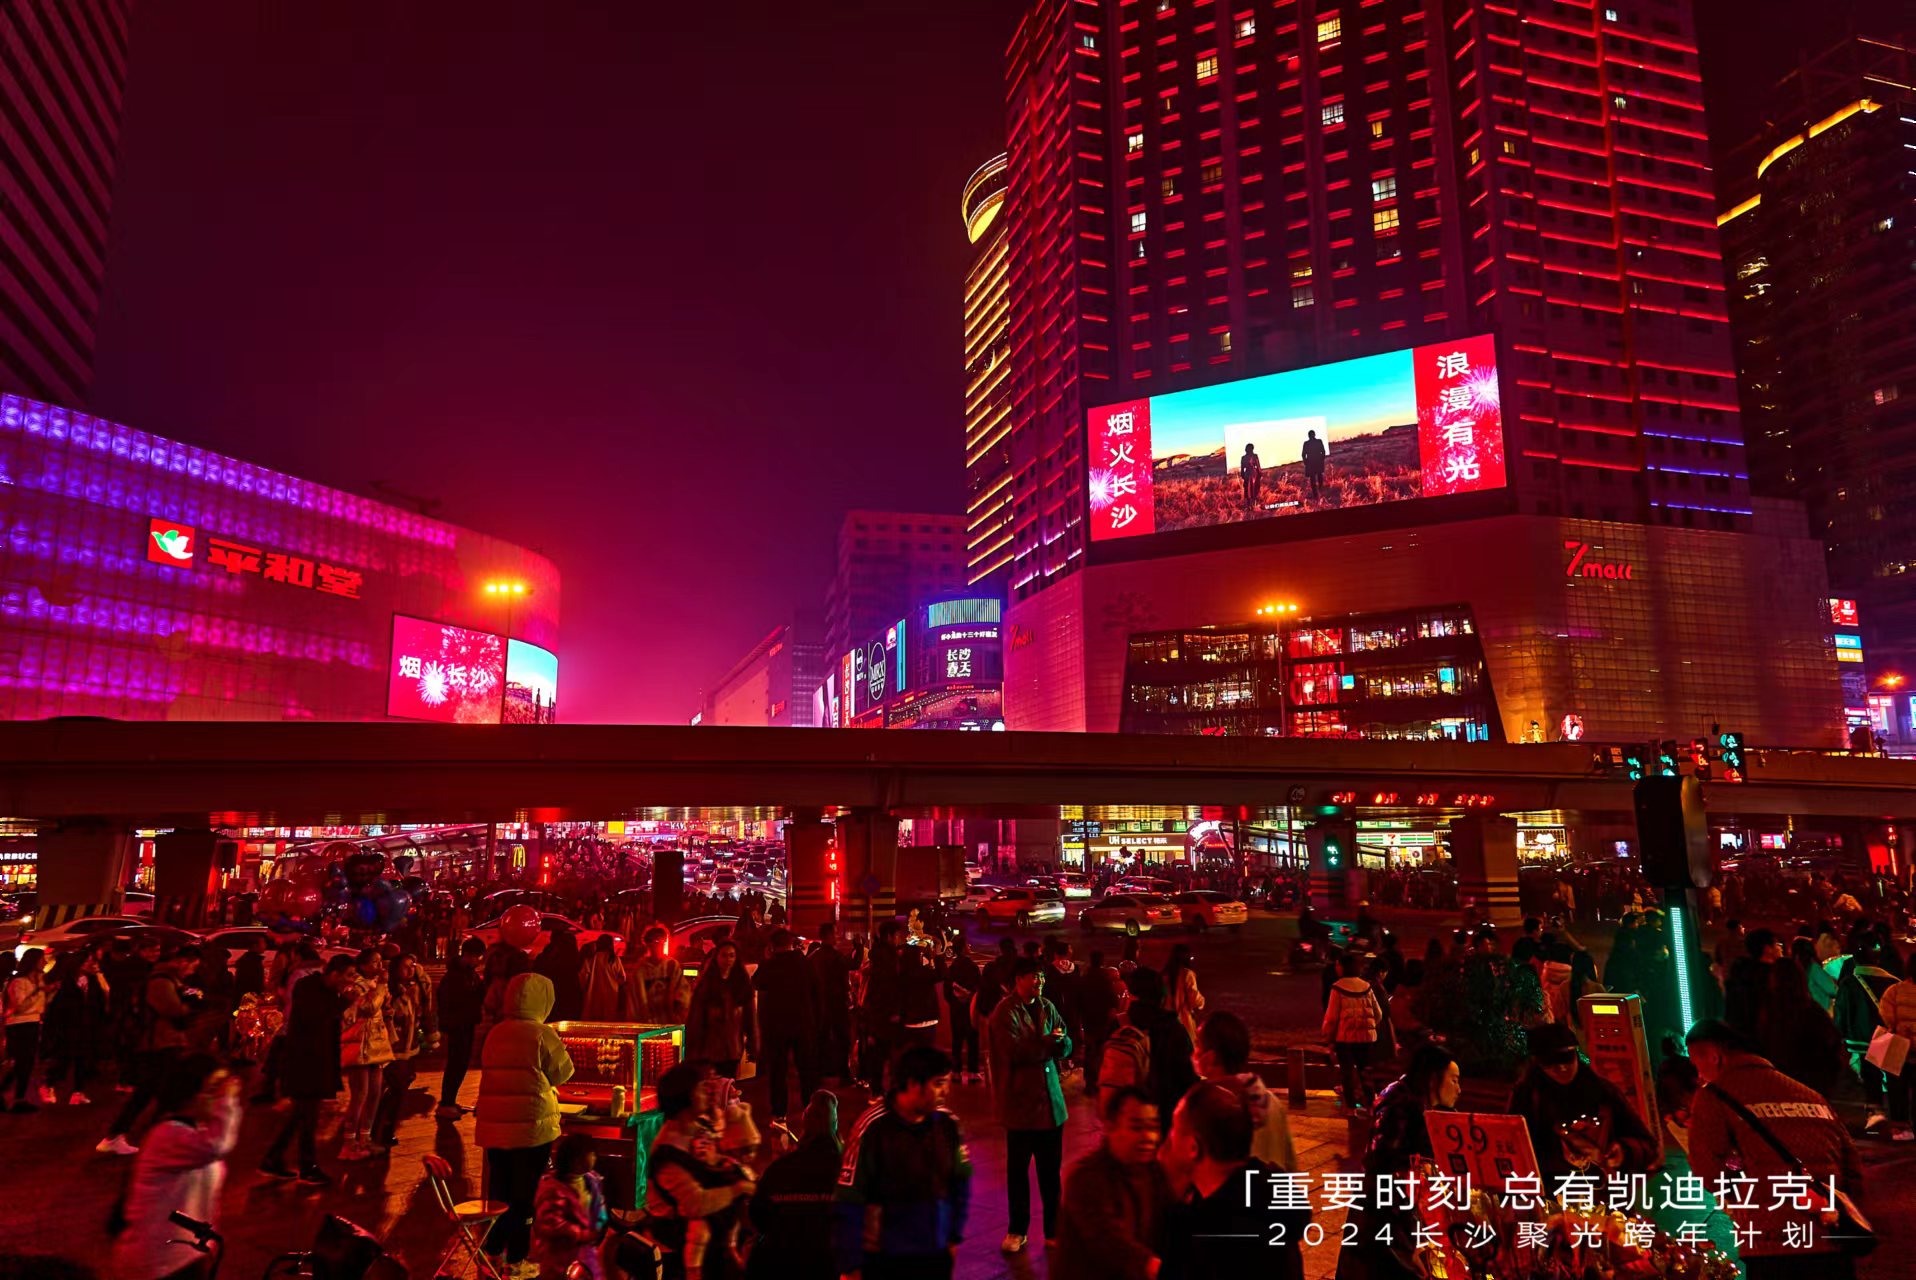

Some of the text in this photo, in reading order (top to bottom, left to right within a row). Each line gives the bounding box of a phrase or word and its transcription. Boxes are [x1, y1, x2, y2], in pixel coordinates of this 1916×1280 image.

[1436, 351, 1480, 484] 浪漫有光
[1106, 411, 1138, 529] 烟火长沙
[207, 537, 363, 599] 平和堂
[398, 654, 491, 689] 烟火长沙
[946, 648, 972, 661] 长沙
[1121, 837, 1153, 845] SELECT
[1446, 1124, 1488, 1154] 9.9
